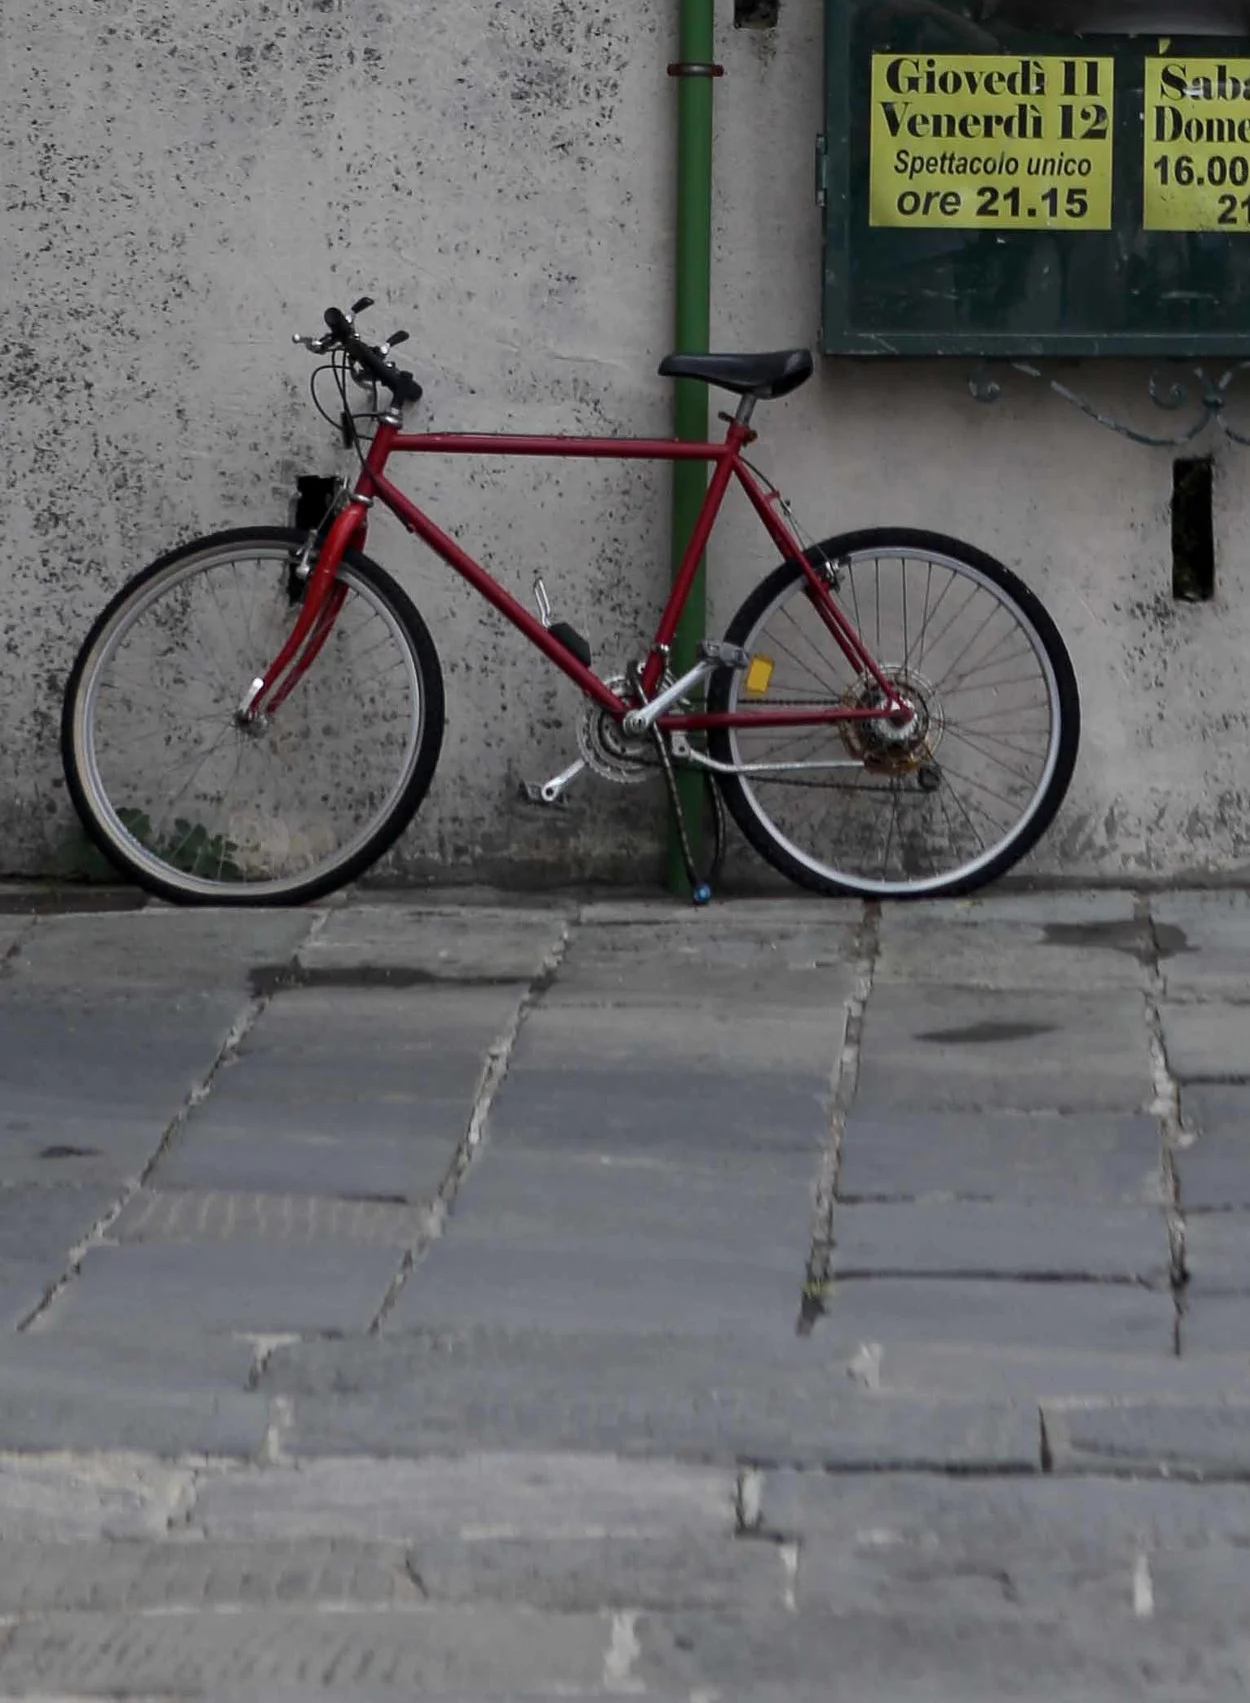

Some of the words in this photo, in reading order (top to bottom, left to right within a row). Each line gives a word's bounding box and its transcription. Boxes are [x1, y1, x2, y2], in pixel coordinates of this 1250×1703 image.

[886, 57, 1047, 96] Giovedì
[1060, 60, 1101, 97] 11
[878, 101, 1043, 139] Venerdì
[1057, 103, 1109, 140] 12
[894, 149, 1019, 179] Spettacolo
[1027, 152, 1092, 177] unico
[1153, 155, 1249, 186] 16.00
[897, 189, 961, 216] ore
[975, 186, 1088, 218] 21.15
